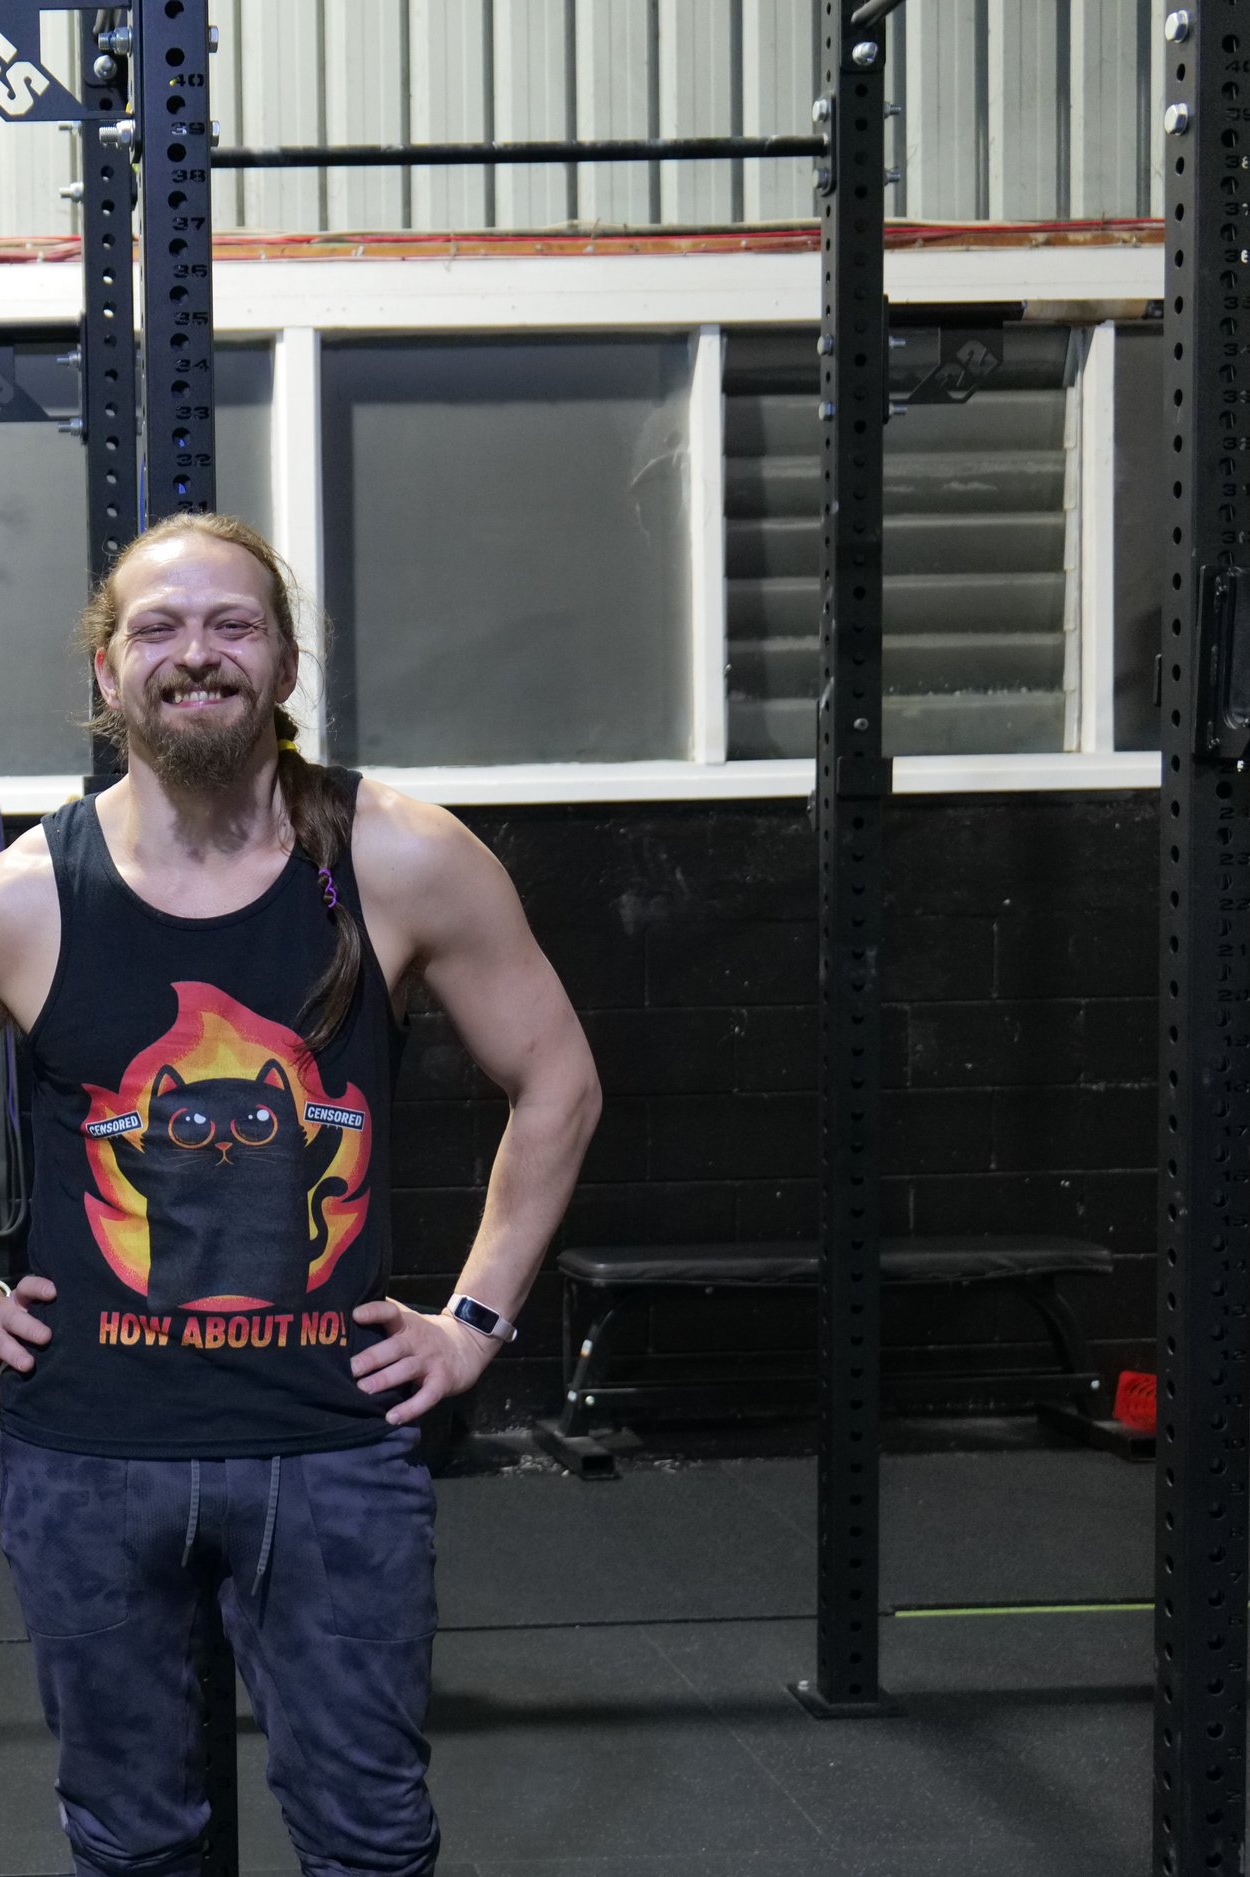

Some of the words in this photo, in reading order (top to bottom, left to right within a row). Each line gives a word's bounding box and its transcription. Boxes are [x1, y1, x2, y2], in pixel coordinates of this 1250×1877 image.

[170, 74, 205, 87] 40
[171, 122, 206, 135] 39
[171, 170, 206, 182] 38
[172, 217, 206, 230] 37
[173, 264, 208, 278] 36
[174, 312, 209, 326] 35
[175, 358, 210, 373] 34
[175, 406, 210, 420] 33
[176, 453, 211, 467] 32
[307, 1106, 363, 1128] CENSORED
[89, 1117, 139, 1136] CENSORED
[99, 1311, 172, 1346] HOW
[181, 1314, 294, 1349] ABOUT
[300, 1311, 347, 1347] NO!
